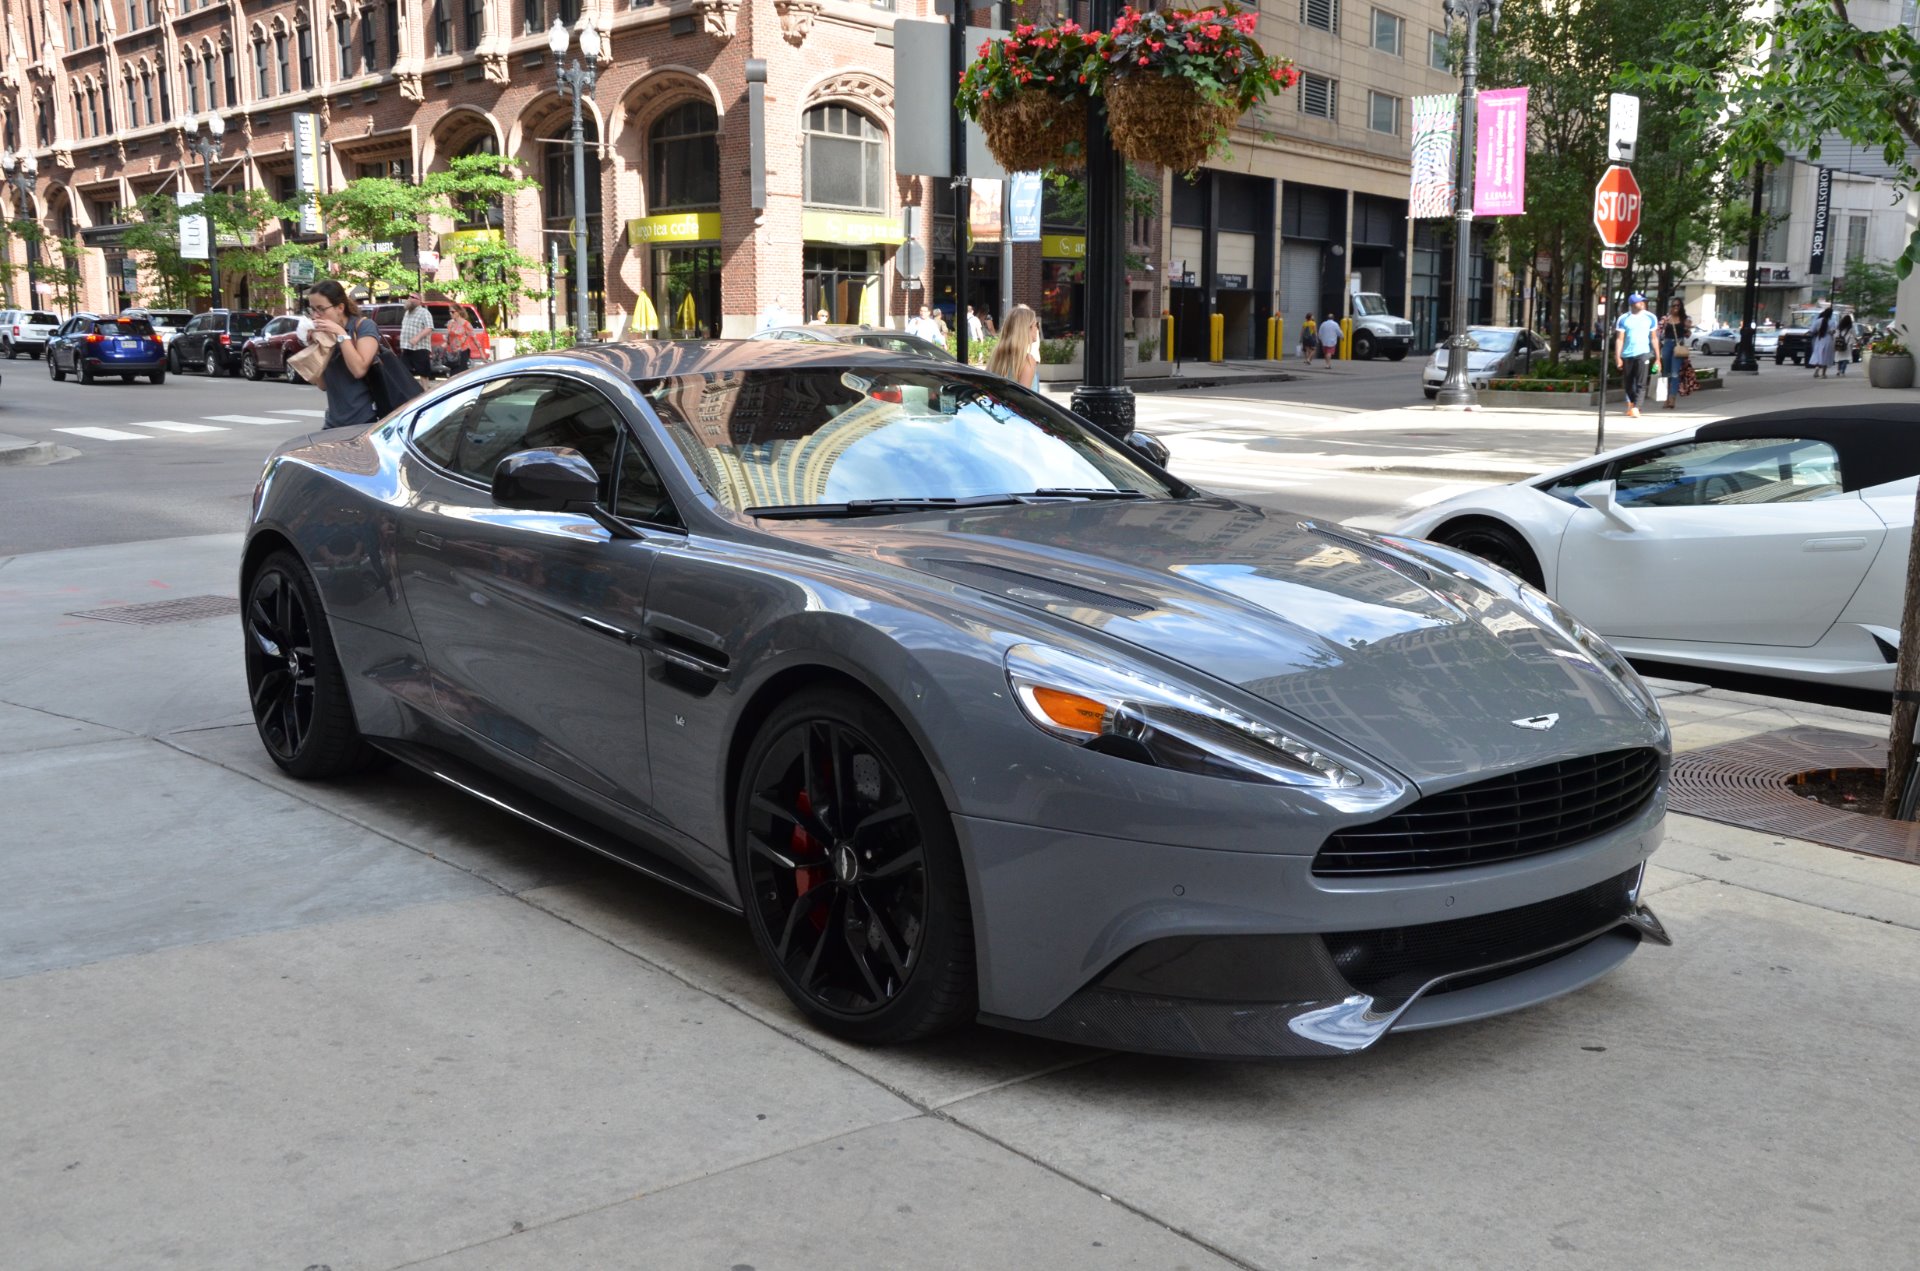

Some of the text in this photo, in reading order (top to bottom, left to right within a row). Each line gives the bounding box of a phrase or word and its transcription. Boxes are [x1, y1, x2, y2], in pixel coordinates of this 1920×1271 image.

[1485, 191, 1513, 200] LUMA
[1598, 191, 1638, 221] STOP
[1812, 168, 1829, 256] NORDSTROM rack
[187, 214, 201, 246] LUM
[653, 223, 668, 236] tea
[670, 214, 699, 236] café
[1605, 253, 1626, 265] ALL WAY
[1772, 266, 1790, 280] rack
